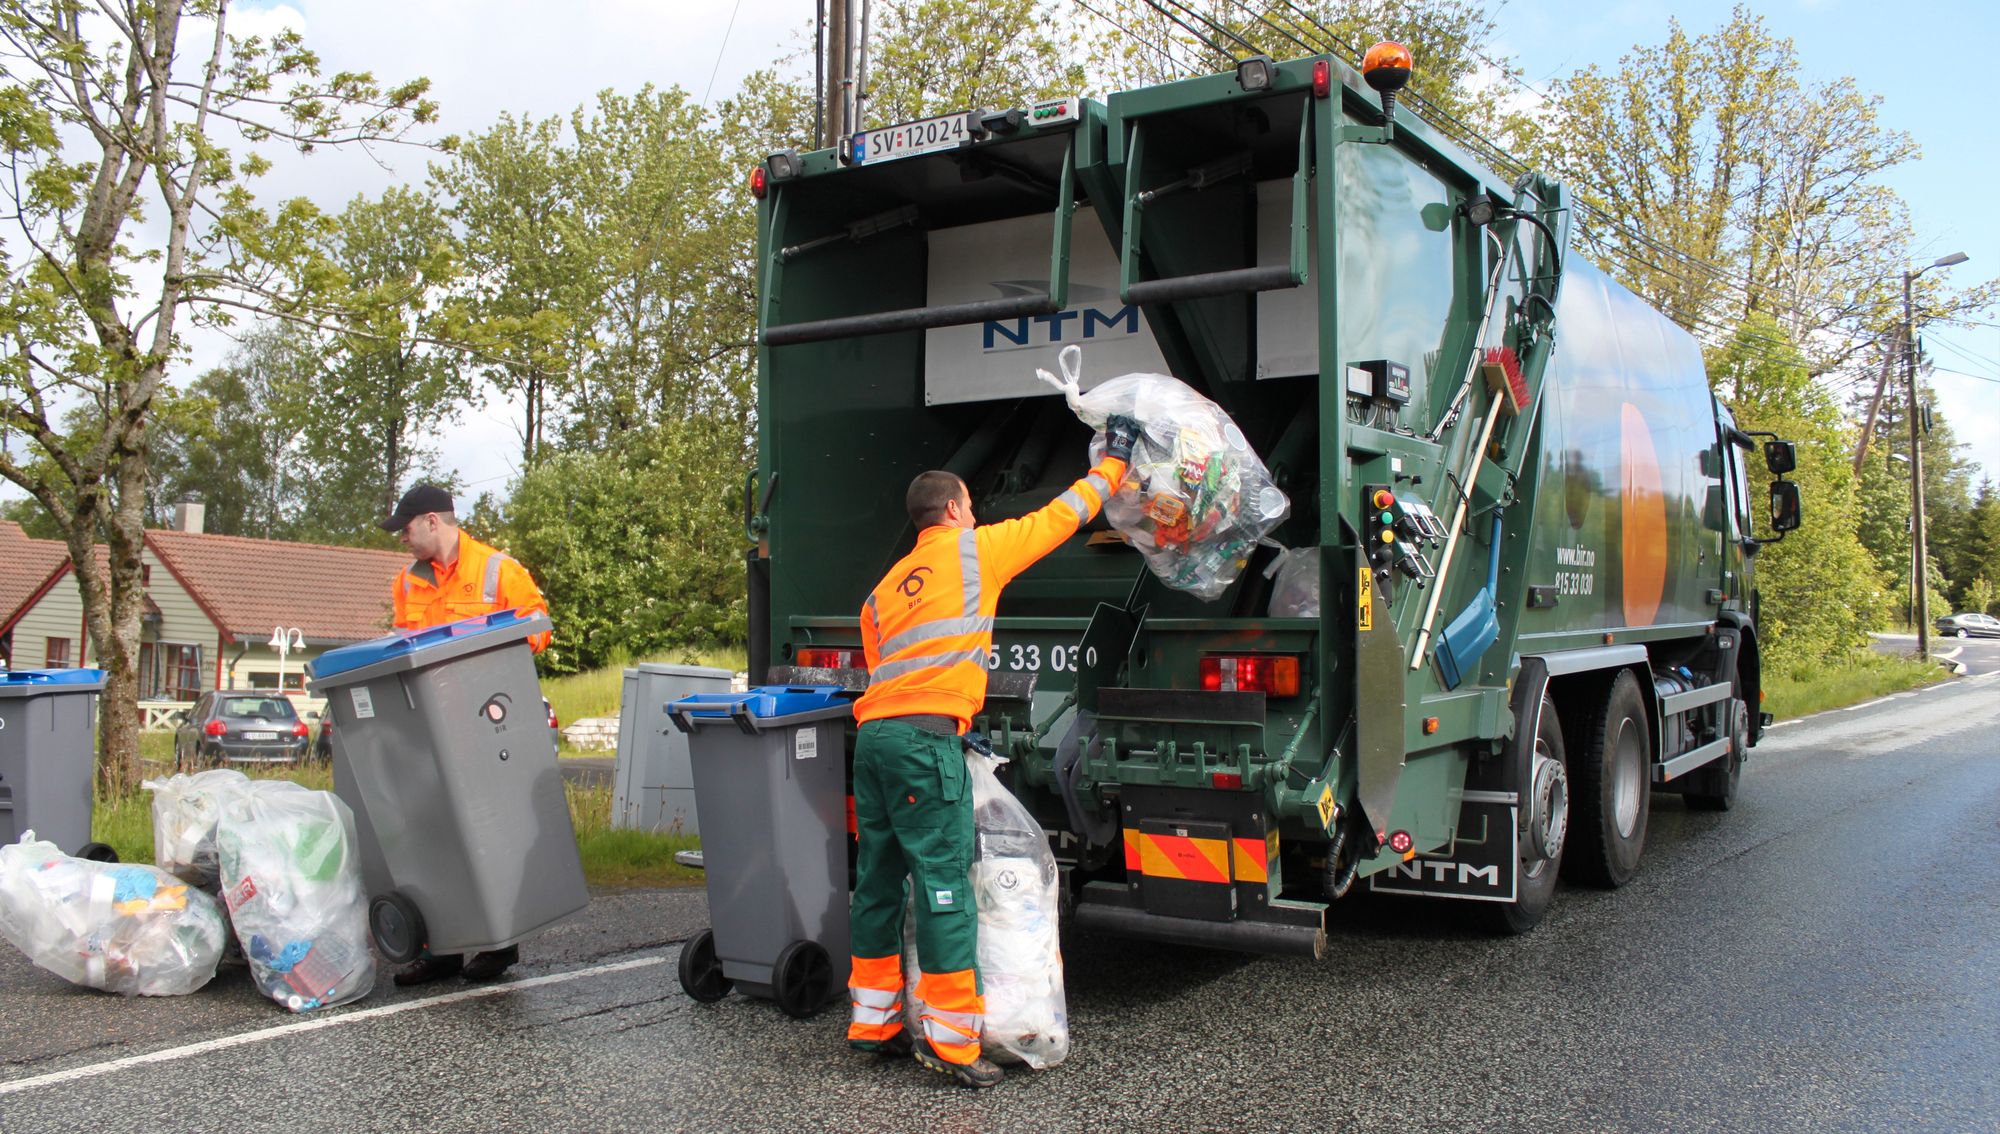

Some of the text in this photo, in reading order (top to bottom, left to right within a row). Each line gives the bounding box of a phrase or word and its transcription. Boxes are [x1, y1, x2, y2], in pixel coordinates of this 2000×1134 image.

[872, 117, 963, 155] SV 12024
[983, 304, 1139, 348] NTM
[1556, 544, 1595, 567] www.bir.no
[1570, 572, 1580, 595] 33
[1580, 573, 1593, 595] 030
[1009, 644, 1040, 671] 33
[1050, 645, 1097, 673] 030
[1388, 860, 1498, 886] NTM
